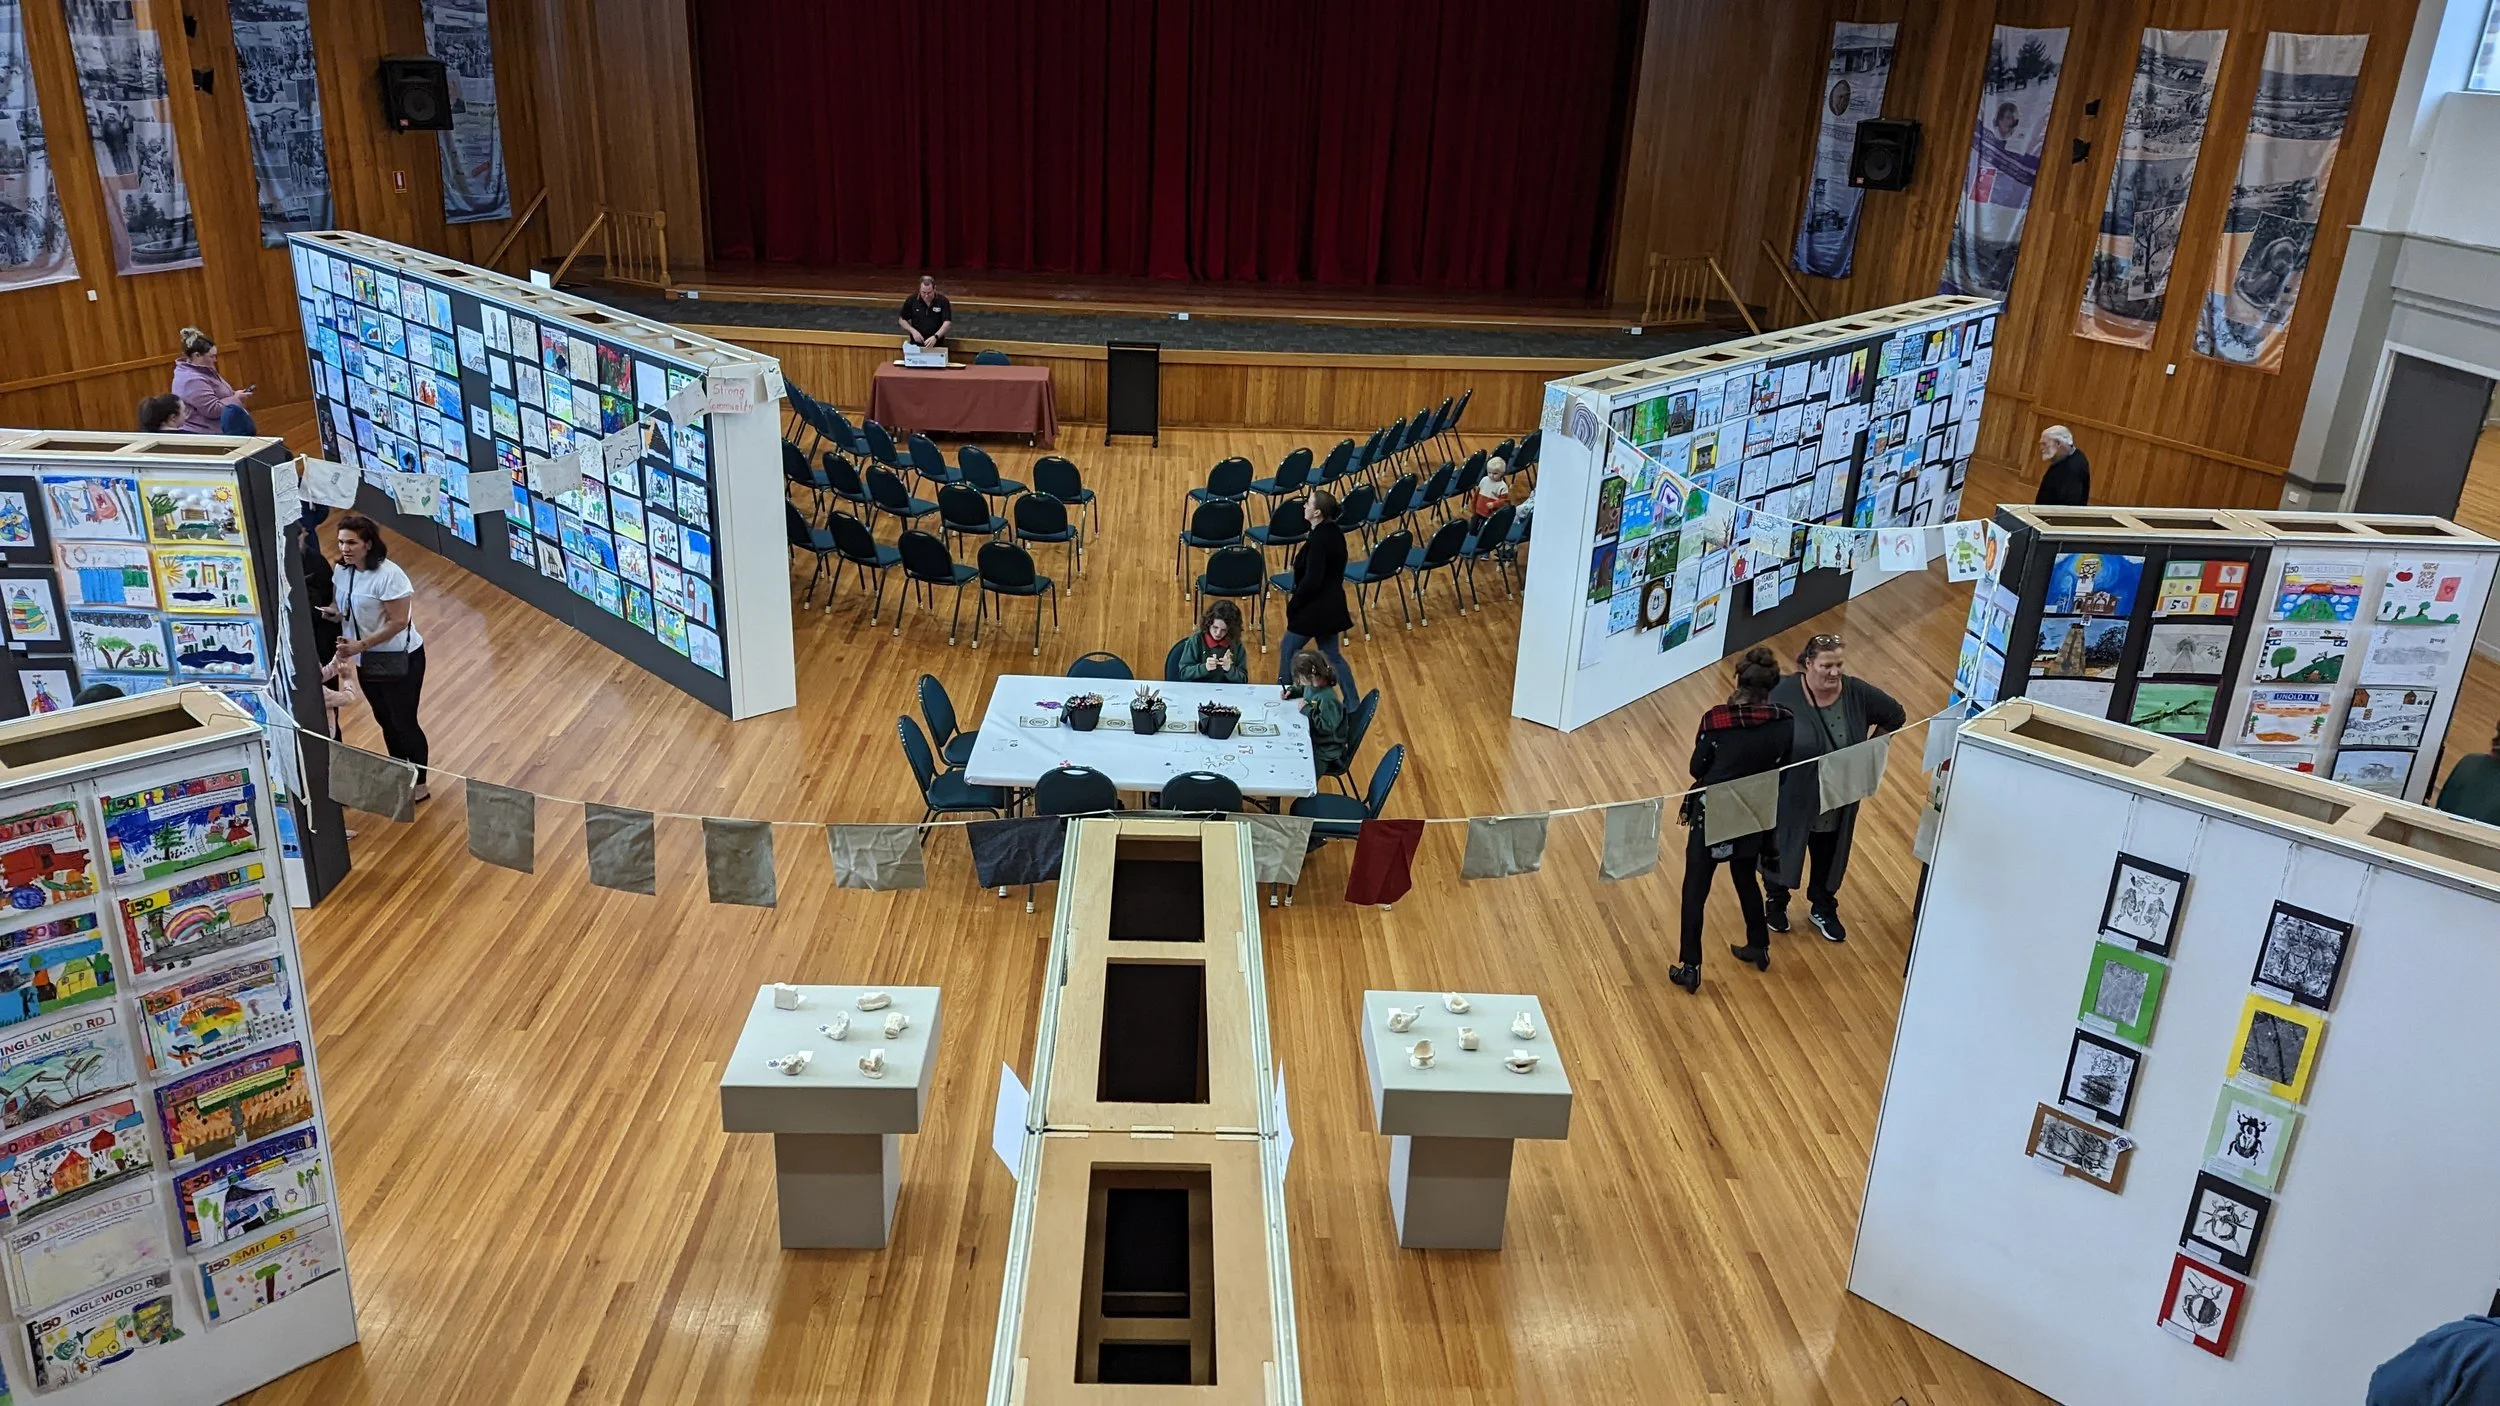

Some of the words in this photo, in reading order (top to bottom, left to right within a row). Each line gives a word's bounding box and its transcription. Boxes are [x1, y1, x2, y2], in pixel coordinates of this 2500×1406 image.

[713, 384, 745, 397] Strong
[0, 1022, 82, 1056] INGLEWOOD
[86, 1016, 105, 1029] RD
[208, 1258, 231, 1274] 150
[37, 1316, 61, 1332] 150
[67, 1282, 142, 1318] INGLEWOOD
[146, 1276, 163, 1289] RD
